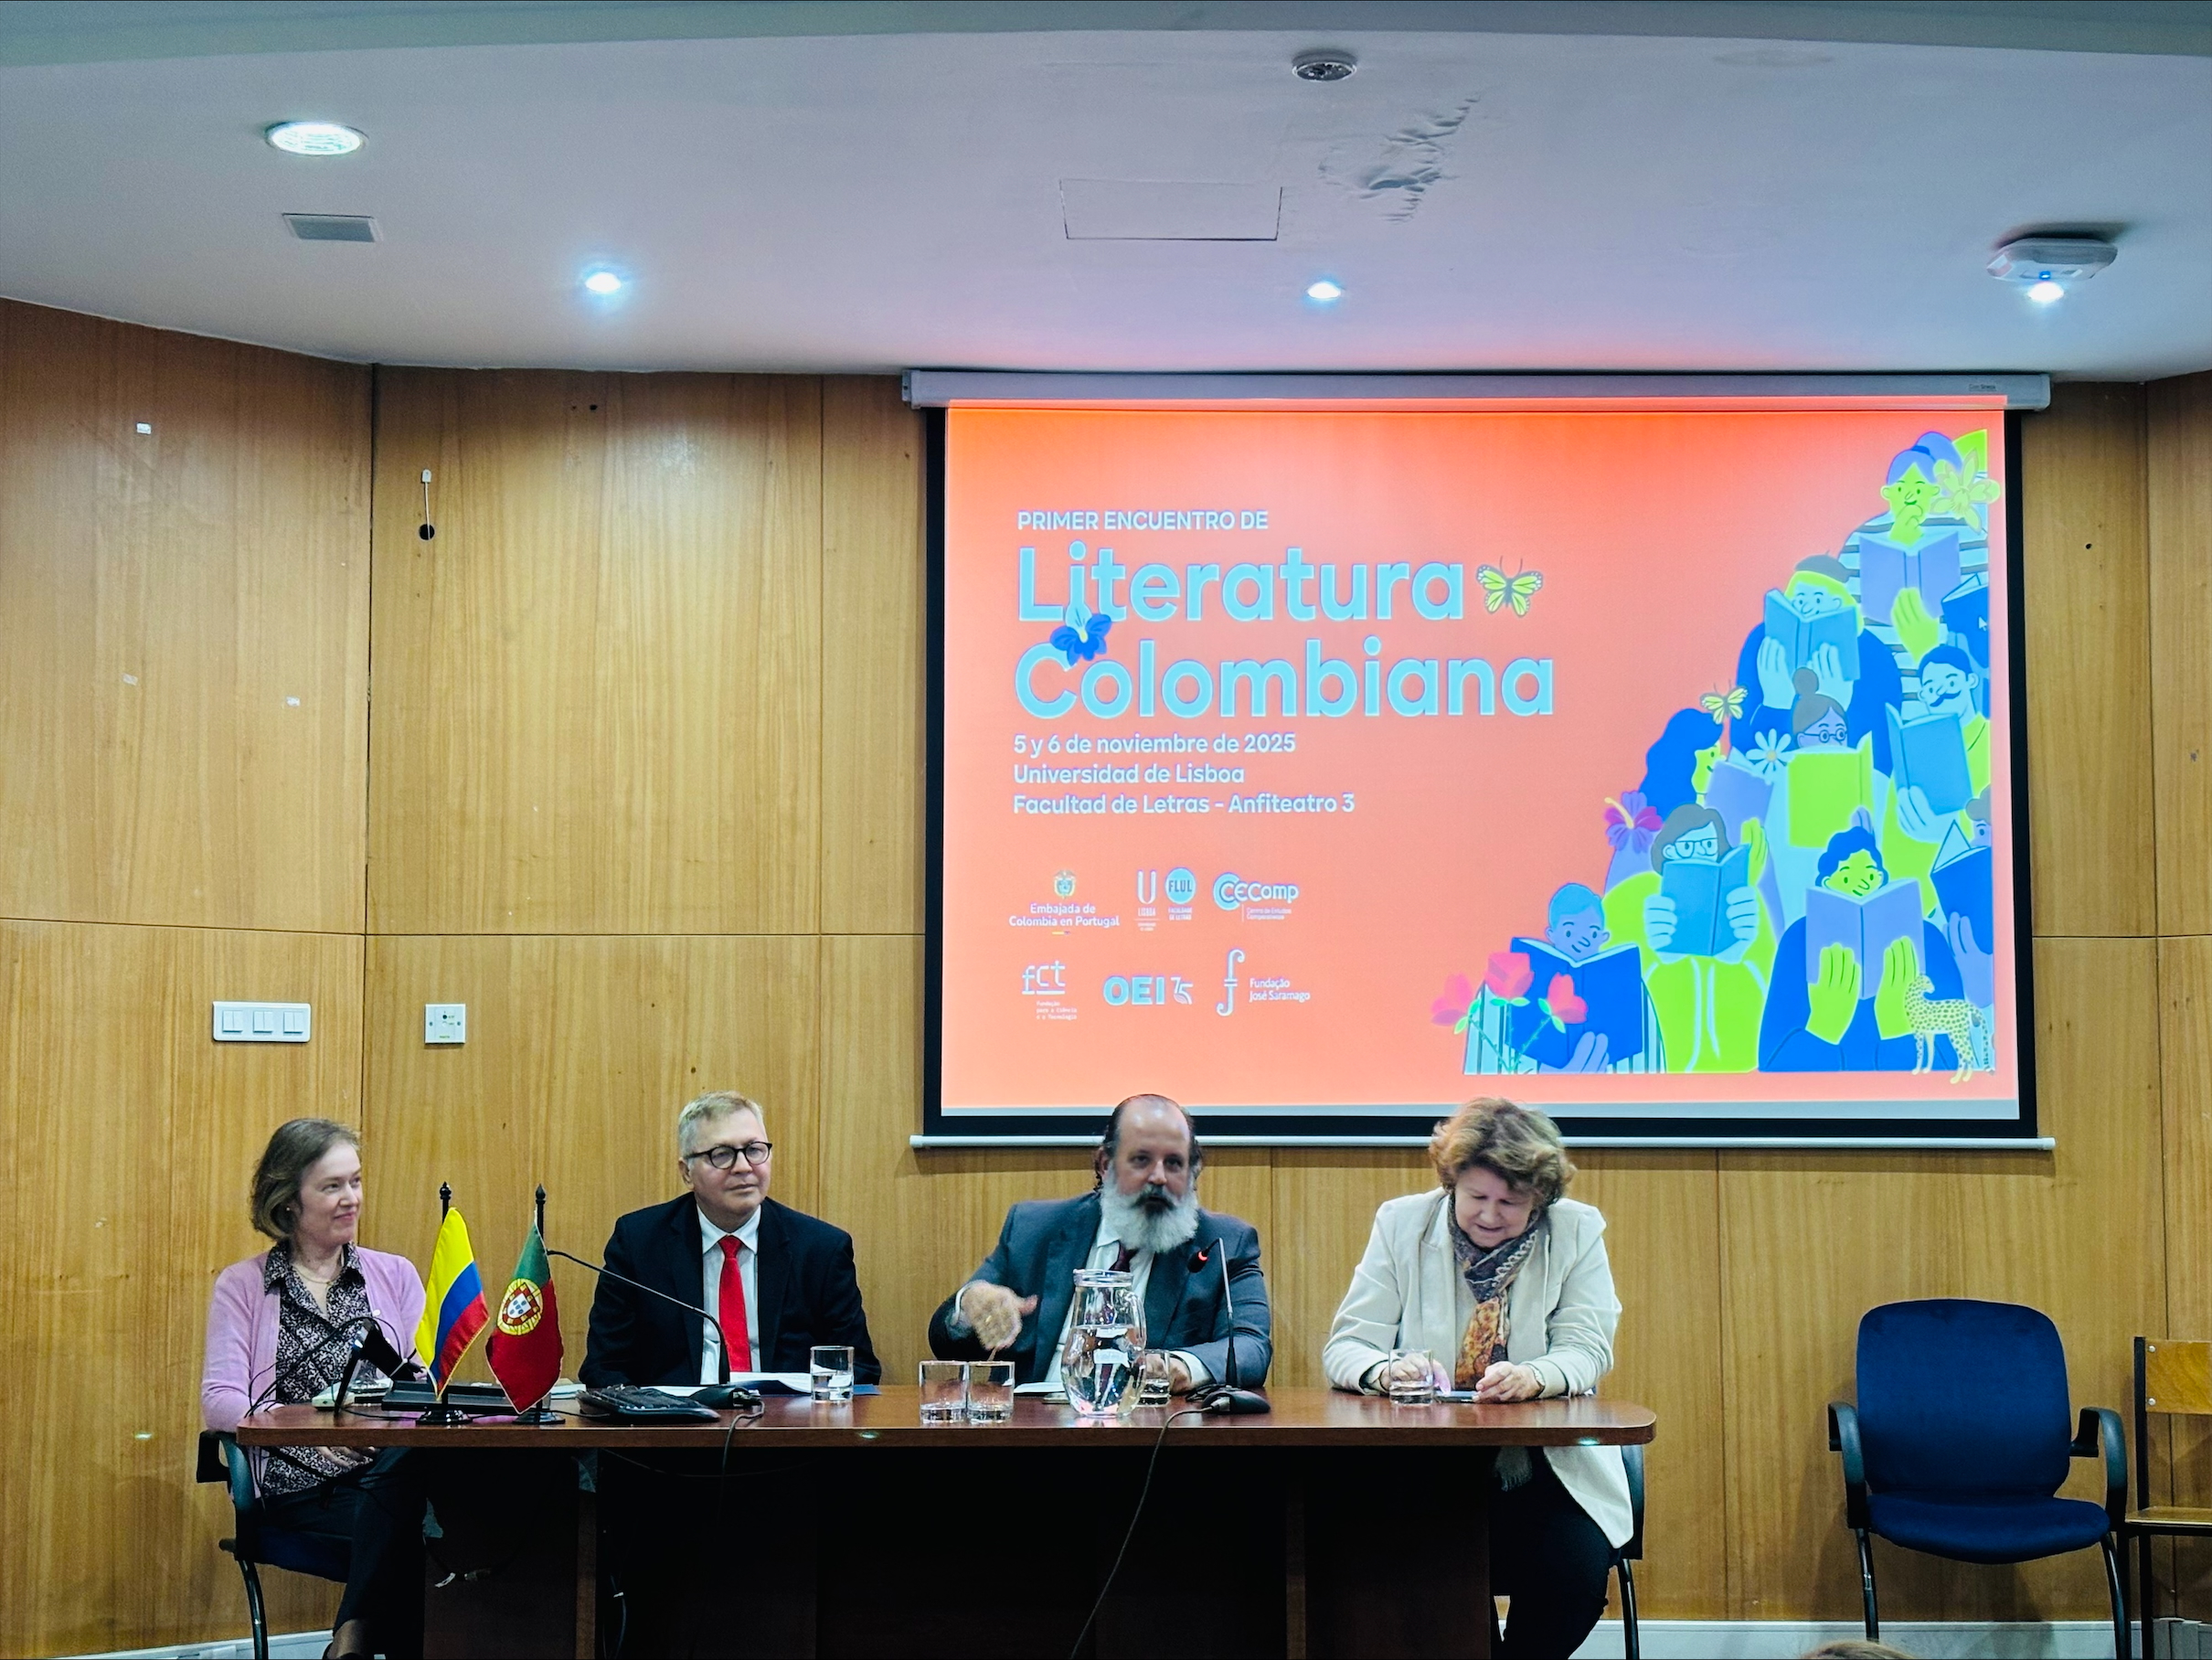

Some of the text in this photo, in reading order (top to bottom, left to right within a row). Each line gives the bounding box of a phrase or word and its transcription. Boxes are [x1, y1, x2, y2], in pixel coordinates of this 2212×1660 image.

[1017, 510, 1269, 531] PRIMER ENCUENTRO DE
[1018, 540, 1464, 622] Literatura
[1015, 634, 1554, 719] Colombiana
[1014, 732, 1296, 759] 5 y 6 de noviembre de 2025
[1014, 762, 1245, 784] Universidad de Lisboa
[1014, 793, 1107, 814] Facultad
[1111, 793, 1138, 814] de
[1143, 793, 1210, 814] Letras
[1228, 792, 1338, 814] Anfiteatro
[1342, 793, 1355, 813] 3
[1137, 869, 1157, 905] U
[1168, 879, 1193, 893] FLUL
[1030, 903, 1096, 916] Embajada de
[1008, 915, 1121, 929] Colombia en Portugal
[1102, 976, 1165, 1006] OEI
[1250, 977, 1291, 990] Fundação
[1249, 990, 1311, 1003] José Saramago
